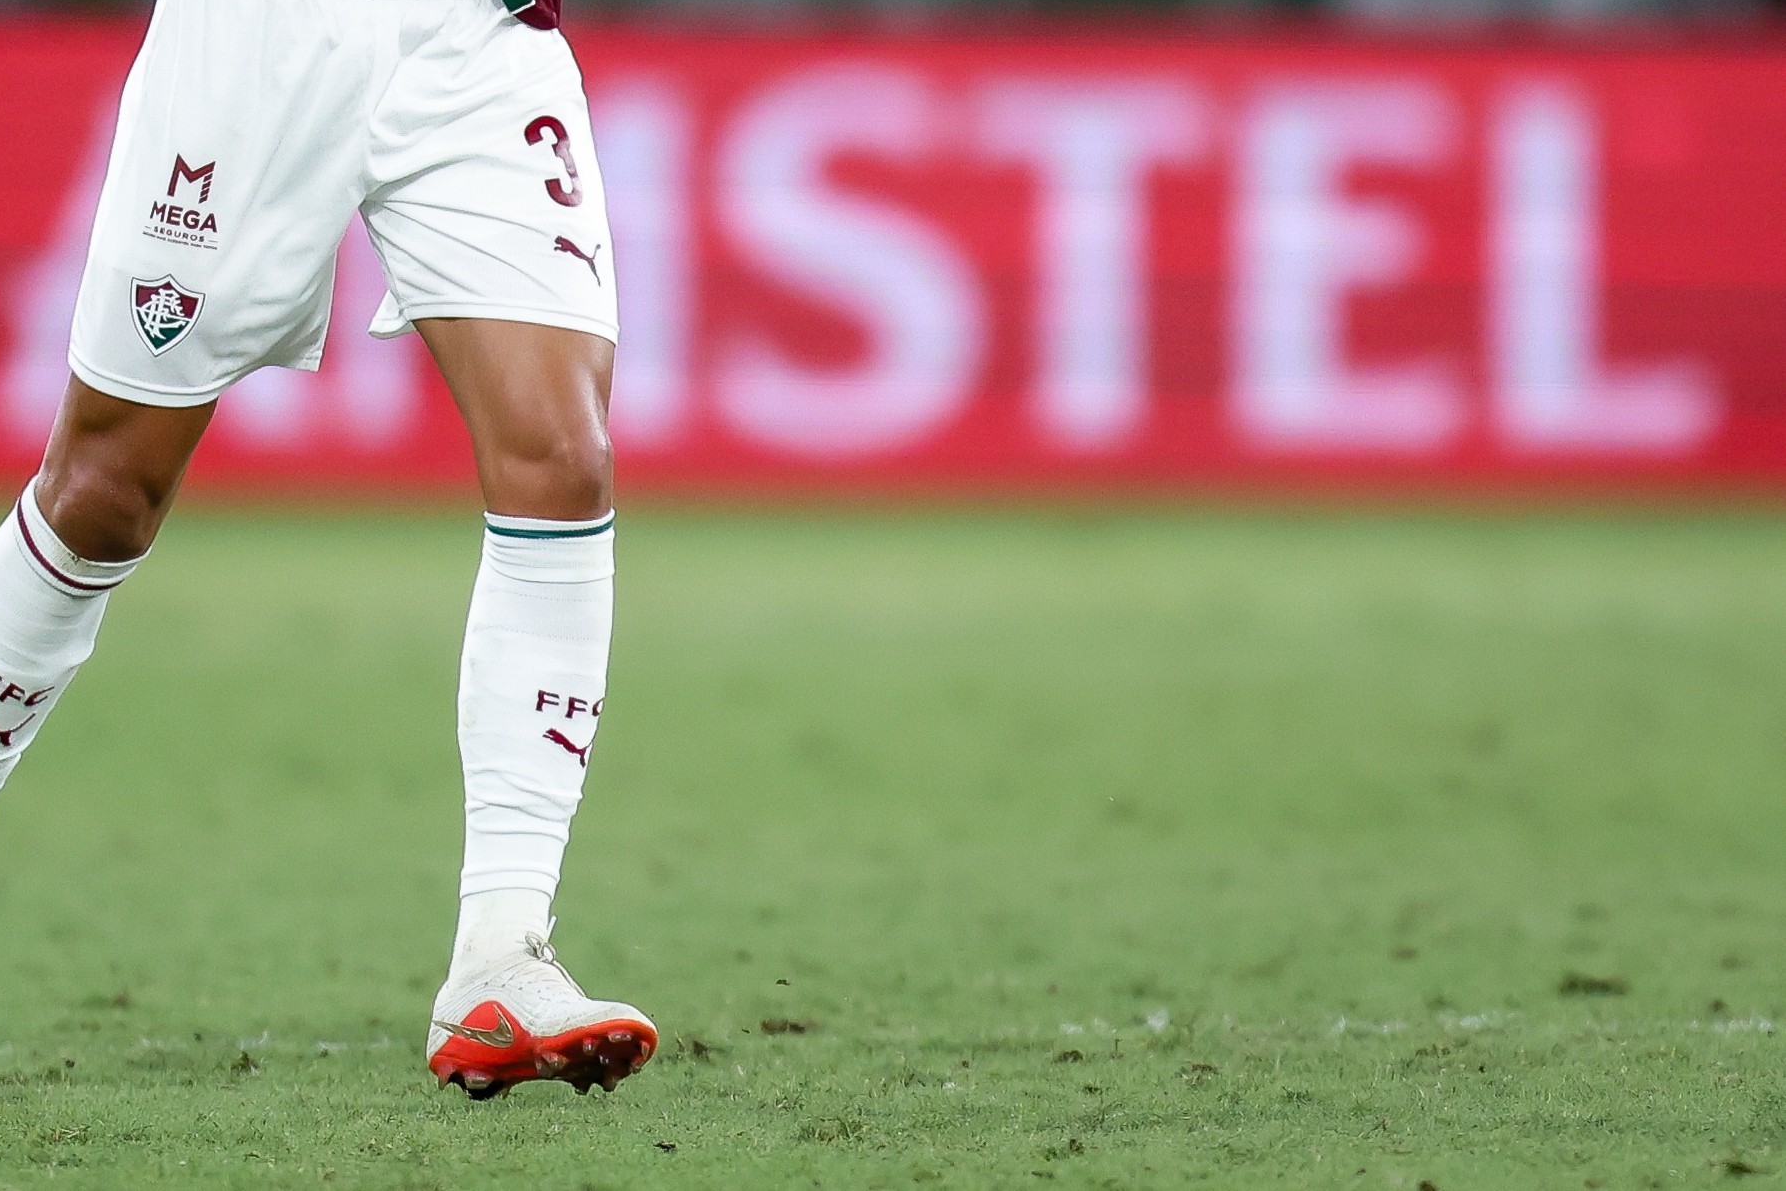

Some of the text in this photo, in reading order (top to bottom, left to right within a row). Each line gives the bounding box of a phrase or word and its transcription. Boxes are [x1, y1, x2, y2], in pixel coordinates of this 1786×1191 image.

[524, 115, 583, 207] 3
[150, 200, 218, 233] MEGA
[153, 226, 206, 243] SEGUROS
